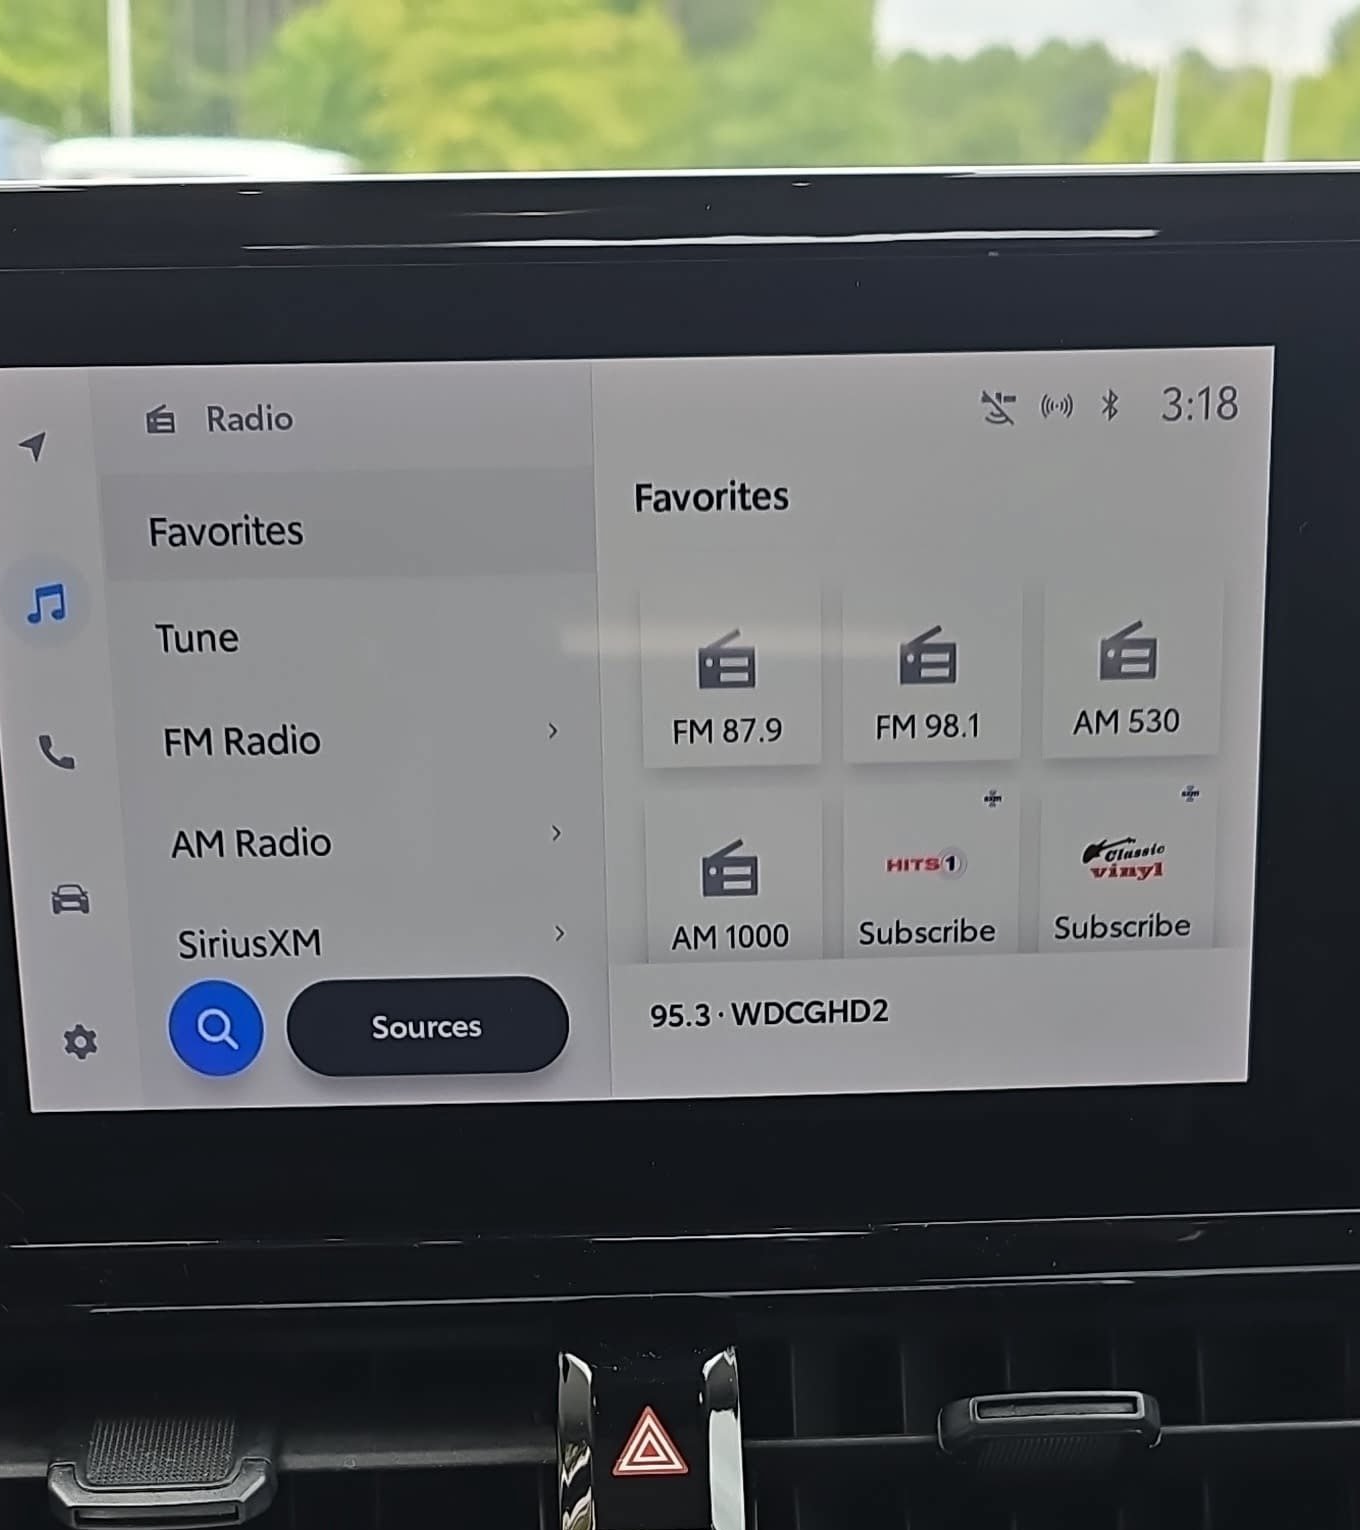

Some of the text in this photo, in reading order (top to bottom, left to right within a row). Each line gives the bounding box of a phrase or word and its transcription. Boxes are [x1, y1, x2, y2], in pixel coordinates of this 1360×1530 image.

[1161, 386, 1239, 422] 3:18
[207, 404, 294, 435] Radio
[635, 481, 789, 514] Favorites
[149, 515, 304, 547] Favorites
[155, 624, 240, 654] Tune
[672, 716, 783, 746] FM 87.9
[875, 712, 980, 741] FM 98.1
[1073, 707, 1180, 736] AM 530
[163, 724, 321, 757] FM Radio
[171, 826, 333, 859] AM Radio
[1090, 861, 1164, 880] vinyl
[671, 922, 789, 951] AM 1000
[858, 918, 996, 947] Subscribe
[1054, 912, 1191, 940] Subscribe
[178, 929, 321, 961] SiriusXM
[372, 1014, 482, 1041] Sources
[651, 999, 889, 1028] 95.3 WDCGHD2
